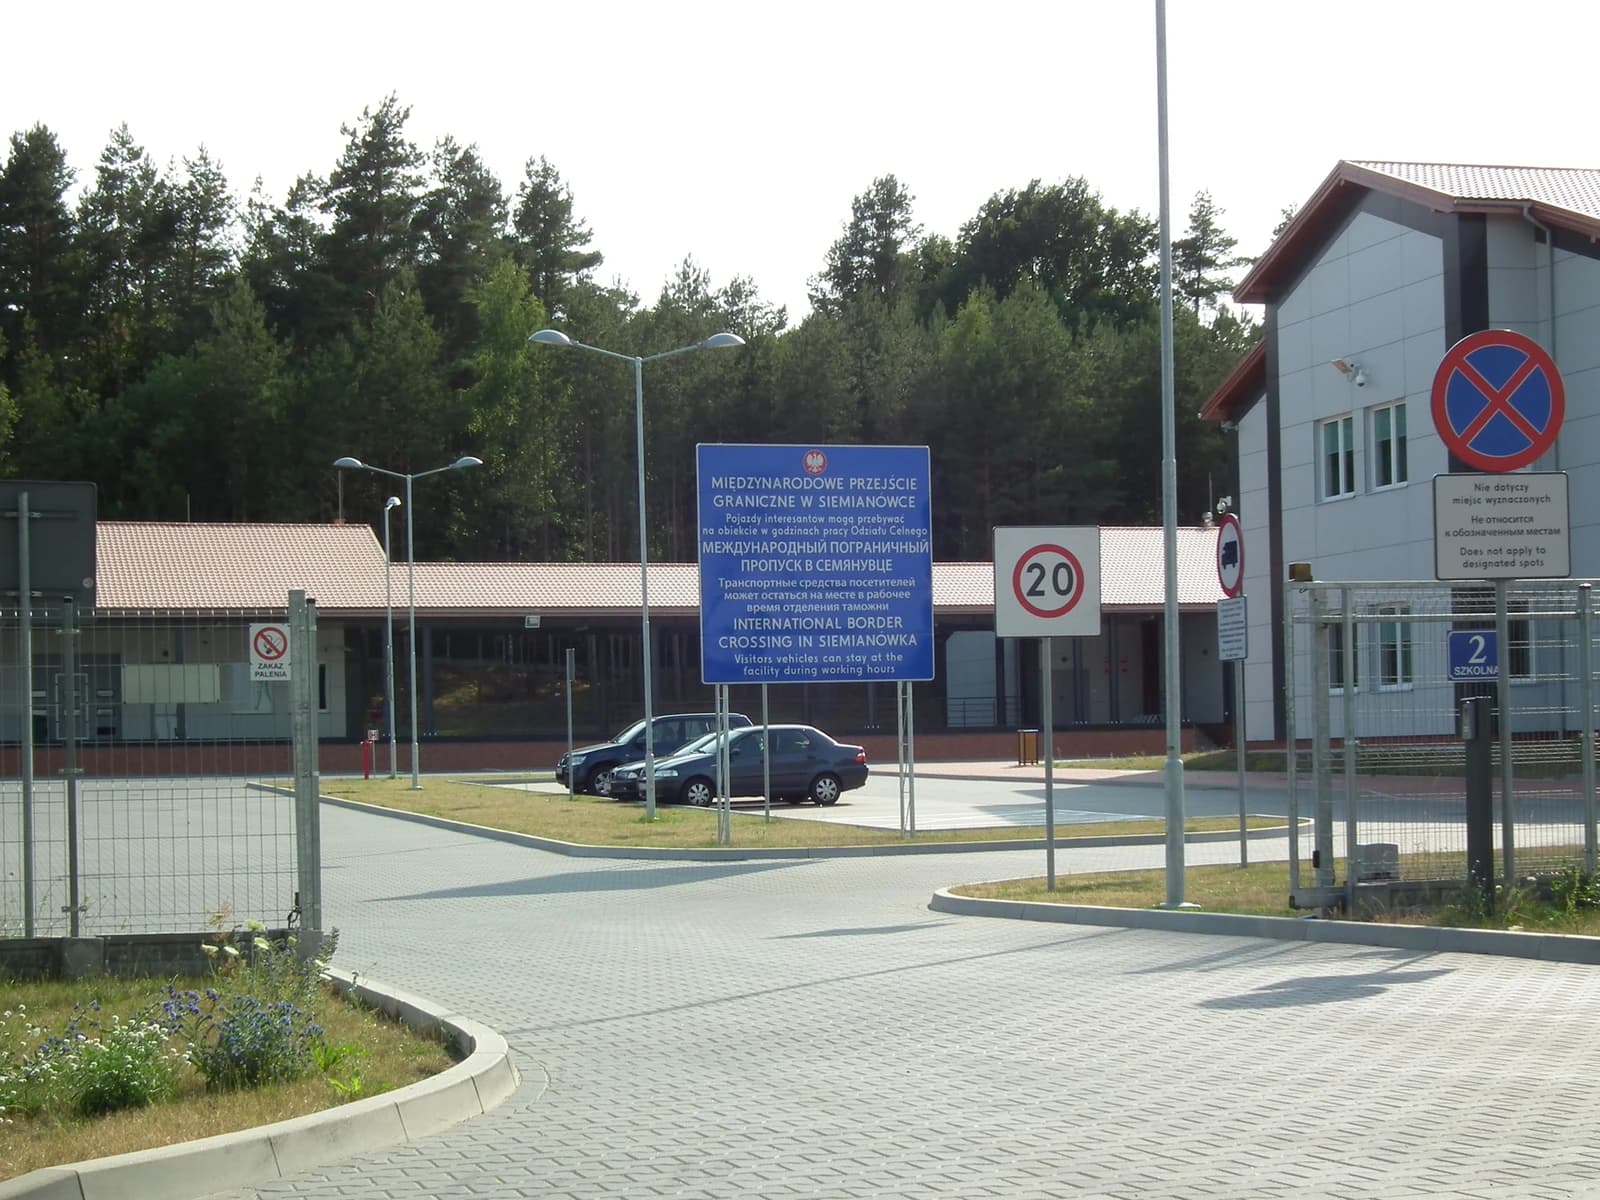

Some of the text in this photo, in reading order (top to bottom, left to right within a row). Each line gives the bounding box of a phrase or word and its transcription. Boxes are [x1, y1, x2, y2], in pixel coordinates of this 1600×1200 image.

[711, 474, 918, 492] MIĘDZYNARODOWE PRZEJŚCIE
[1474, 483, 1529, 493] Nie dotyczy
[713, 492, 916, 508] GRANICZNE W SIEMIANÓWCE
[1452, 494, 1551, 506] miejsc wyznaczonych
[726, 513, 761, 526] Pojazdy
[1471, 515, 1534, 524] Не относится
[702, 527, 715, 536] na
[718, 525, 758, 536] obiekcie
[761, 528, 769, 536] w
[771, 526, 819, 538] godzinach
[823, 528, 848, 538] pracy
[889, 525, 928, 538] Celnego
[1452, 528, 1525, 537] обозначенным
[1526, 528, 1561, 536] местам
[702, 538, 929, 557] МЕЖДУНАРОДНЫЙ ПОГРАНИЧНЫЙ
[1460, 546, 1546, 557] Does not apply to
[741, 559, 893, 574] ПРОПУСК В СЕМЯНУВЦЕ
[1462, 559, 1544, 570] designated spots
[718, 576, 916, 590] Транспортные средства посетителей
[1026, 562, 1074, 597] 20
[724, 588, 911, 601] может остаться на месте в рабочее
[746, 602, 889, 615] время отделения таможни
[733, 616, 904, 630] INTERNATIONAL BORDER
[718, 631, 918, 649] CROSSING IN SIEMIANÓWKA
[1468, 635, 1487, 664] 2
[734, 652, 904, 664] Visitors vehicles can stay at the
[743, 664, 895, 678] facility during working hours
